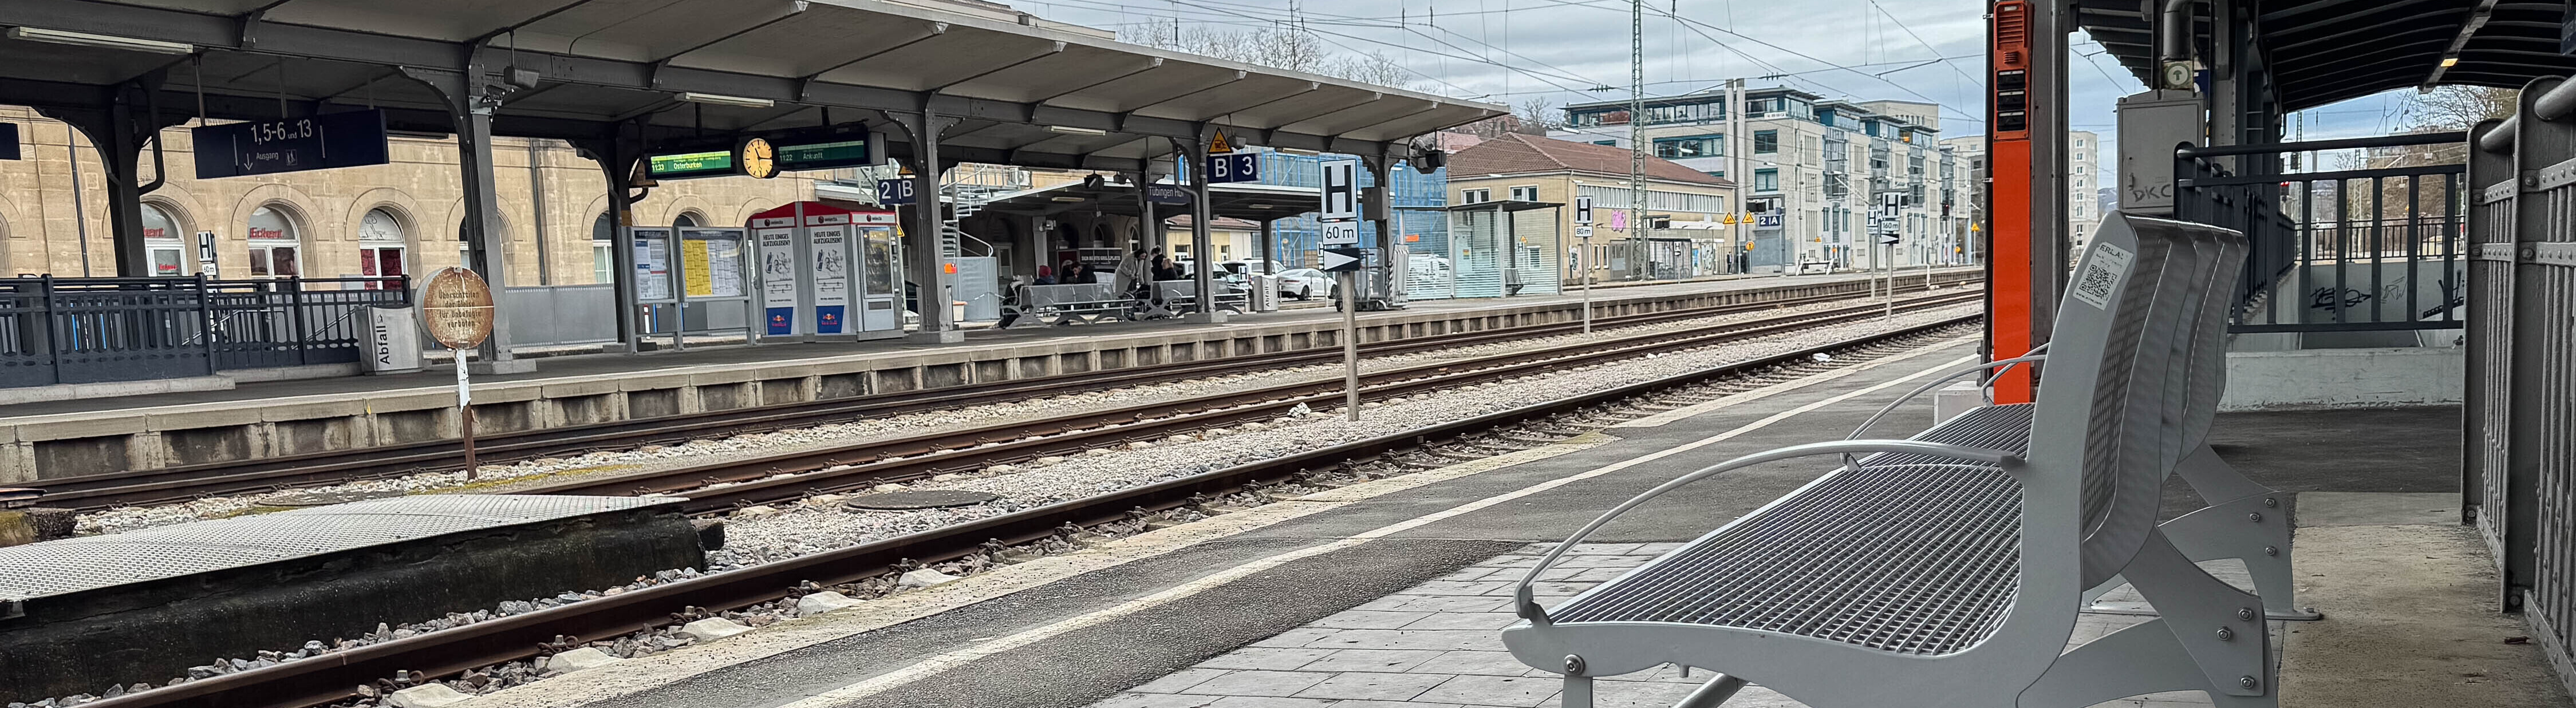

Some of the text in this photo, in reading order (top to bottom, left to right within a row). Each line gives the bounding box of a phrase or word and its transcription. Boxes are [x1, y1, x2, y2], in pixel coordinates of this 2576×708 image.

[251, 121, 286, 145] 1,5-6
[297, 118, 312, 137] 13
[256, 152, 279, 161] Ausgang
[673, 162, 703, 170] Osterburken
[1215, 156, 1253, 177] B 3
[881, 180, 914, 199] 2 B
[1324, 164, 1352, 213] H
[1577, 199, 1591, 221] H
[1885, 195, 1899, 216] H
[1760, 216, 1778, 225] 2 A
[1868, 211, 1876, 224] H
[1326, 226, 1354, 239] 60 m
[198, 232, 211, 259] H
[1240, 267, 1247, 279] H
[448, 320, 475, 328] verboten
[376, 325, 390, 365] Abfall
